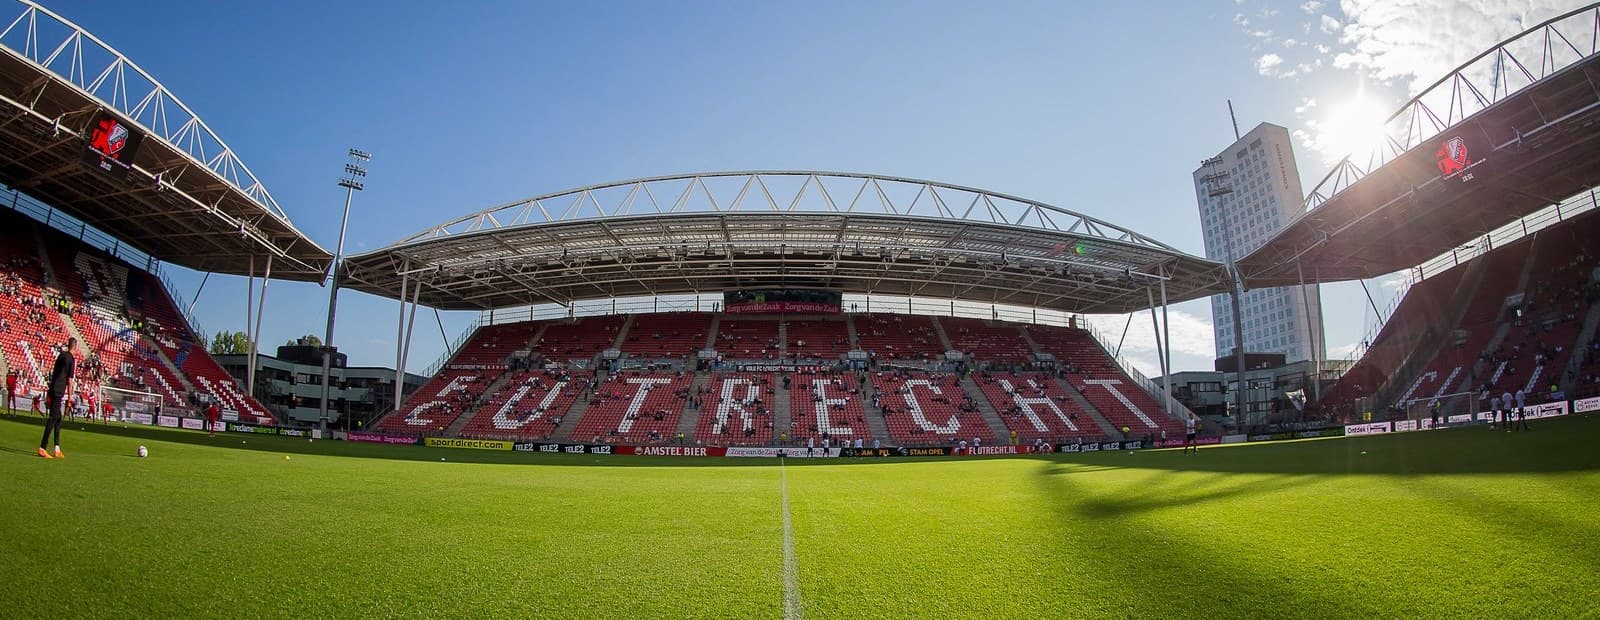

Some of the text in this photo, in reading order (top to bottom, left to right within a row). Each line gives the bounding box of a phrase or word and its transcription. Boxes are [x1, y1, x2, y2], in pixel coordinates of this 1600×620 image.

[515, 443, 533, 451] TELE2
[540, 444, 559, 452] TELE2
[565, 445, 585, 453] TELE2
[591, 445, 611, 454] TELE2
[643, 446, 707, 456] AMSTEL BIER
[1061, 443, 1079, 453] TELE2
